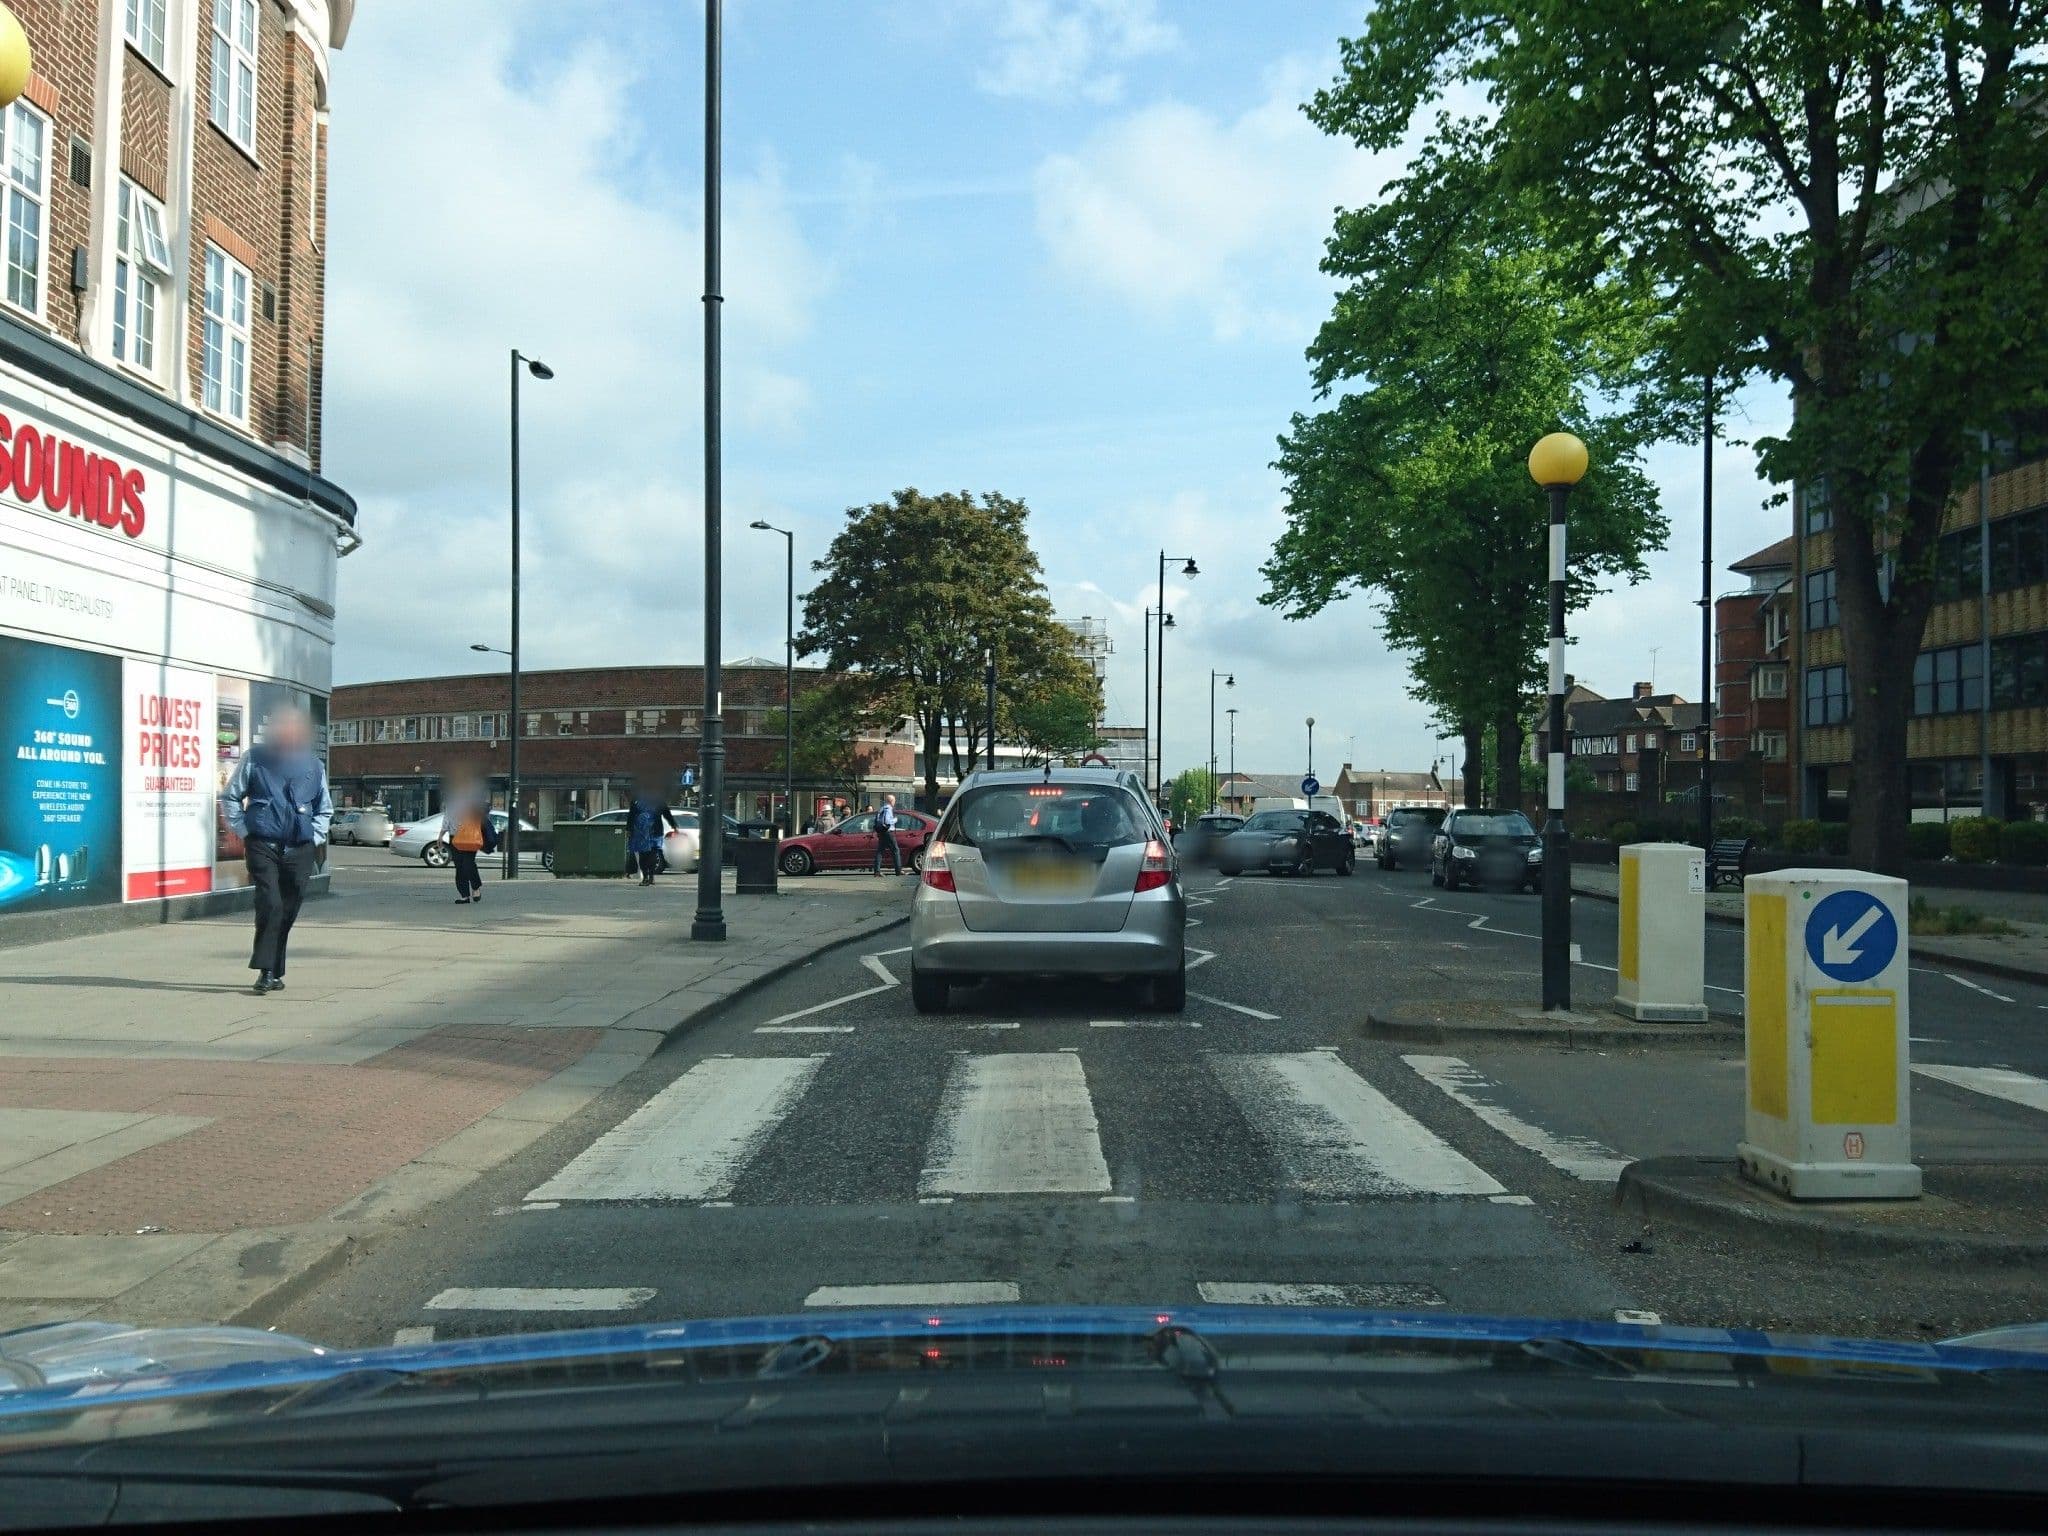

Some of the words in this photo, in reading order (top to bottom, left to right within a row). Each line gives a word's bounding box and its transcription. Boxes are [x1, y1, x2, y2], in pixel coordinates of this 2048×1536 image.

[11, 578, 42, 603] PANEL
[44, 586, 56, 606] TV
[140, 693, 201, 730] LOWEST
[58, 732, 92, 747] SOUND
[17, 746, 38, 761] ALL
[40, 748, 81, 764] AROUND
[82, 752, 106, 765] YOU.
[139, 731, 201, 769] PRICES
[36, 780, 54, 788] COME
[54, 780, 79, 790] IN-STORE
[80, 781, 89, 790] TO
[144, 776, 196, 792] GUARANTEED!
[32, 791, 67, 801] EXPERIENCE
[67, 792, 78, 801] THE
[79, 792, 91, 801] NEW
[39, 802, 67, 811] WIRELESS
[67, 803, 85, 812] AUDIO
[56, 814, 81, 823] SPEAKER
